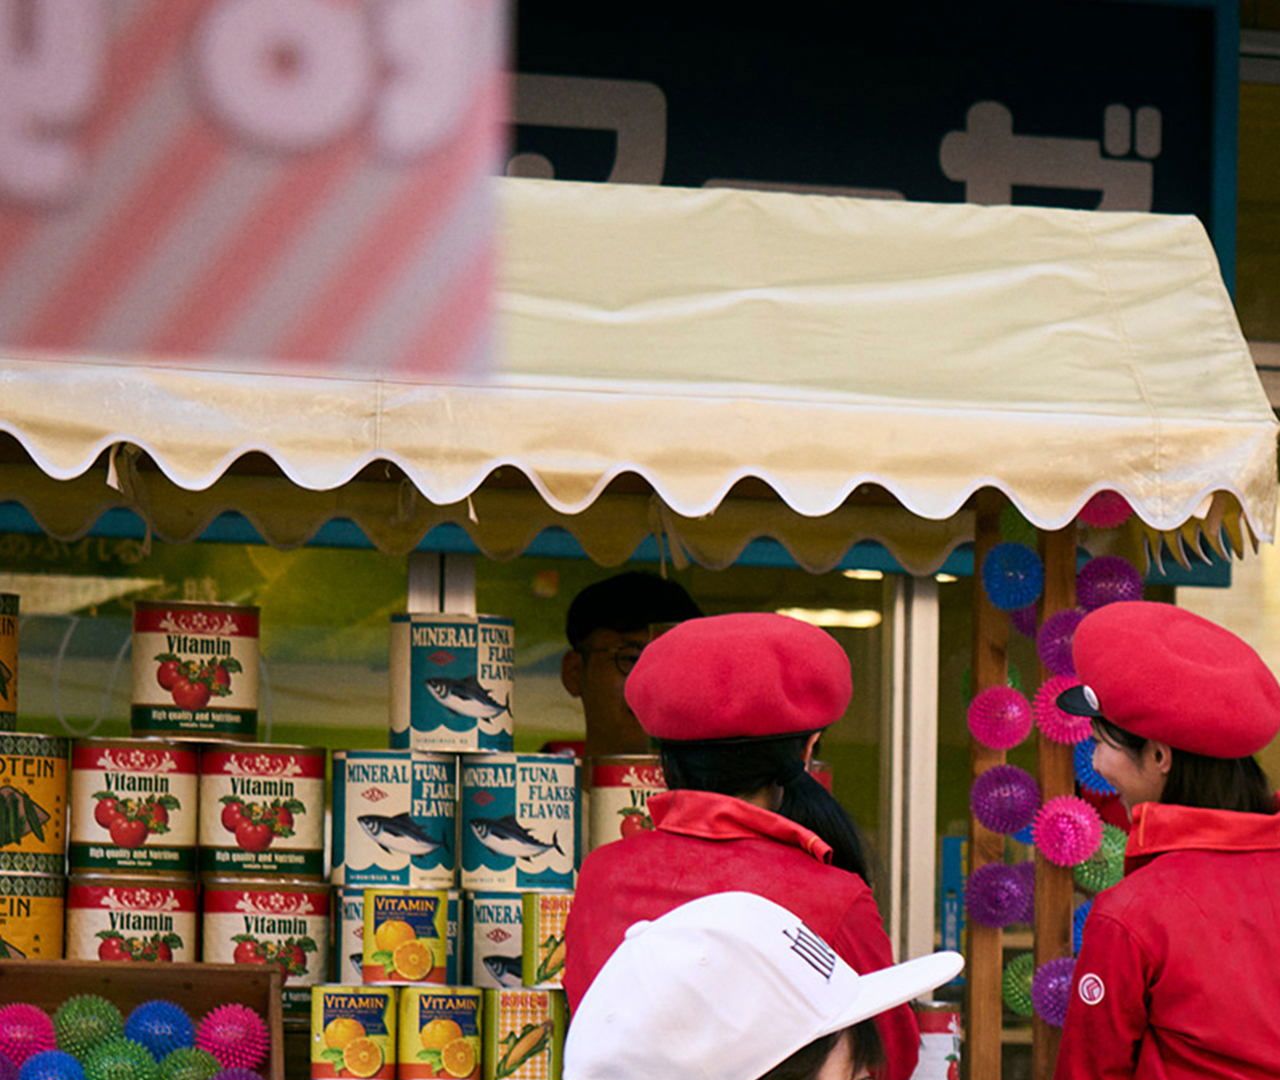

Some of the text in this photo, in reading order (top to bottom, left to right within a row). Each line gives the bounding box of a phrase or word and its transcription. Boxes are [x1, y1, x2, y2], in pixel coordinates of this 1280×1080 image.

[166, 634, 232, 656] Vitamin
[412, 626, 477, 647] MINERAL
[480, 627, 510, 645] TUNA
[347, 764, 410, 784] MINERAL
[414, 763, 449, 782] TUNA
[520, 767, 559, 784] TUNA
[105, 772, 169, 793] Vitamin
[231, 777, 294, 797] Vitamin
[529, 785, 576, 802] FLAKES
[520, 803, 571, 820] FLAVOR
[375, 896, 435, 912] VITAMIN
[108, 911, 173, 932] Vitamin
[474, 903, 523, 925] MINERA
[243, 915, 307, 936] Vitamin
[324, 995, 384, 1010] VITAMIN
[420, 995, 477, 1010] VITAMIN
